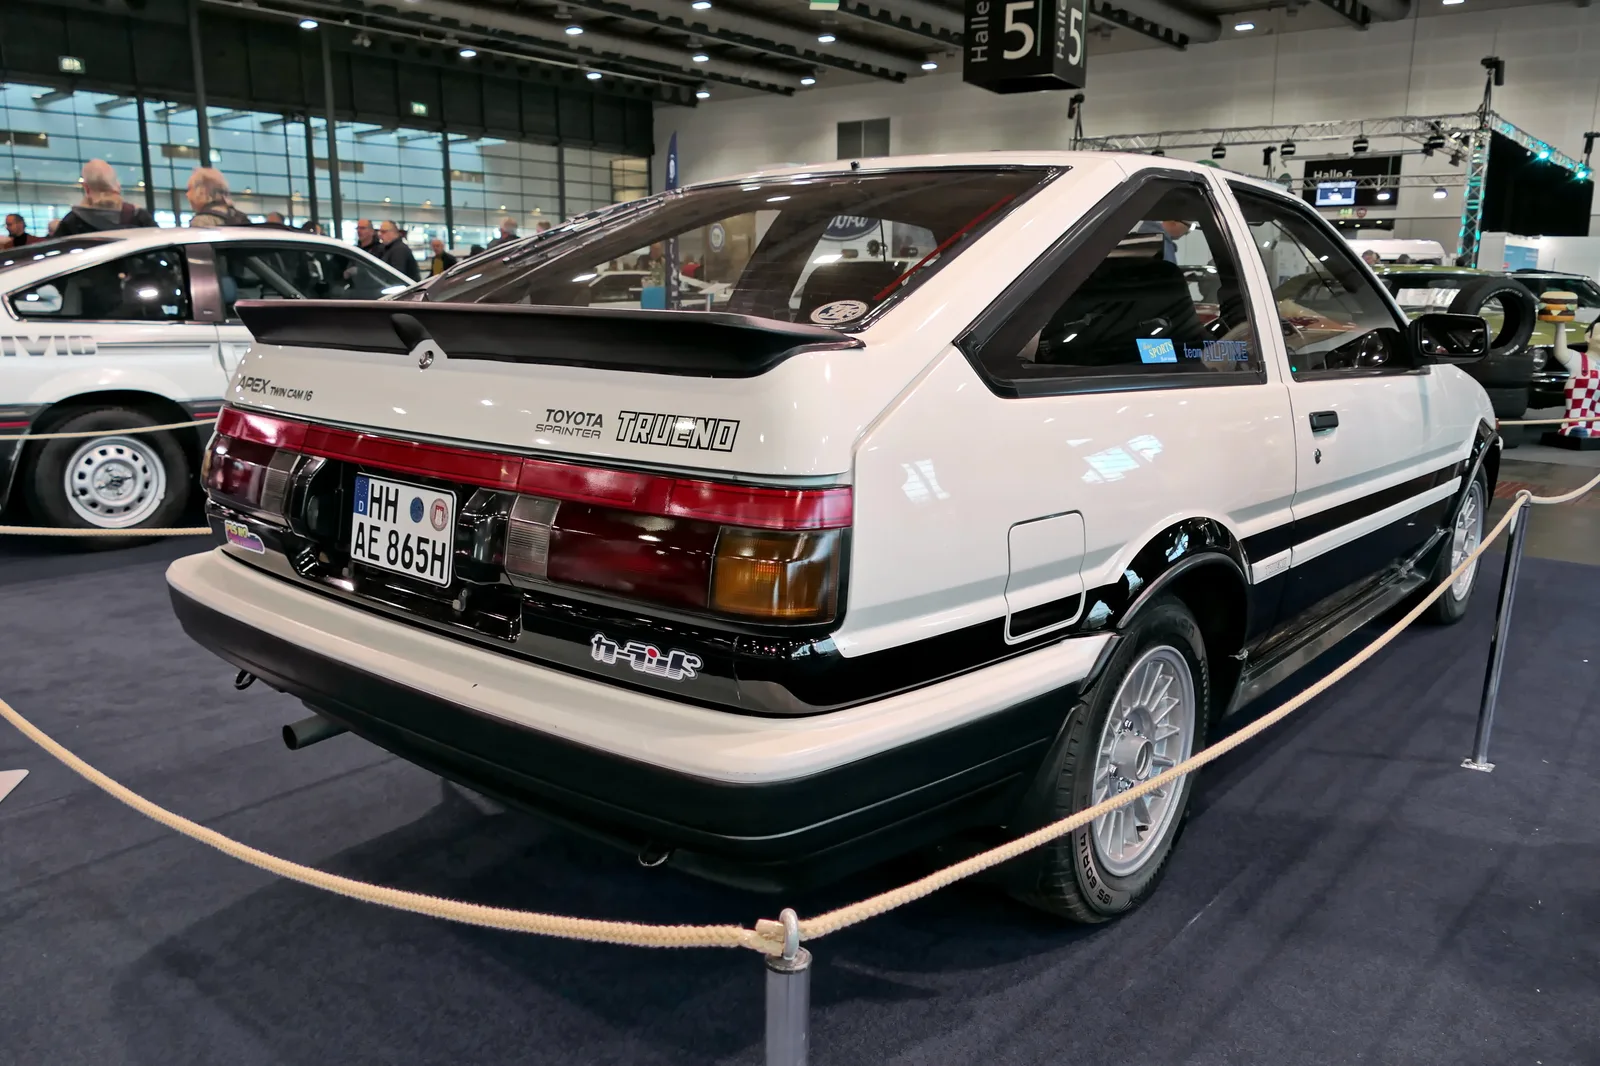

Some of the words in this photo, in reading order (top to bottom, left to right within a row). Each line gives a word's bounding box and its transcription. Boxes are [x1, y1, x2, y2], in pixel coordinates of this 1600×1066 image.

[970, 0, 990, 63] Halle
[1003, 0, 1035, 60] 5
[1068, 7, 1083, 66] 5
[1313, 169, 1344, 179] Halle
[1345, 169, 1353, 179] 6
[1148, 341, 1174, 359] SPORTS
[1183, 342, 1203, 359] team
[1203, 340, 1249, 362] ALPINE
[237, 375, 271, 395] APEX
[270, 386, 288, 398] TWIN
[286, 388, 304, 399] CAM
[303, 390, 314, 401] 16
[535, 423, 602, 440] SPRINTER
[546, 408, 604, 428] TOYOTA
[616, 410, 741, 453] TRUENO
[358, 500, 365, 512] D
[369, 483, 400, 524] HH
[353, 521, 381, 562] AE
[386, 529, 447, 580] 865H
[591, 633, 702, 681] カーランド
